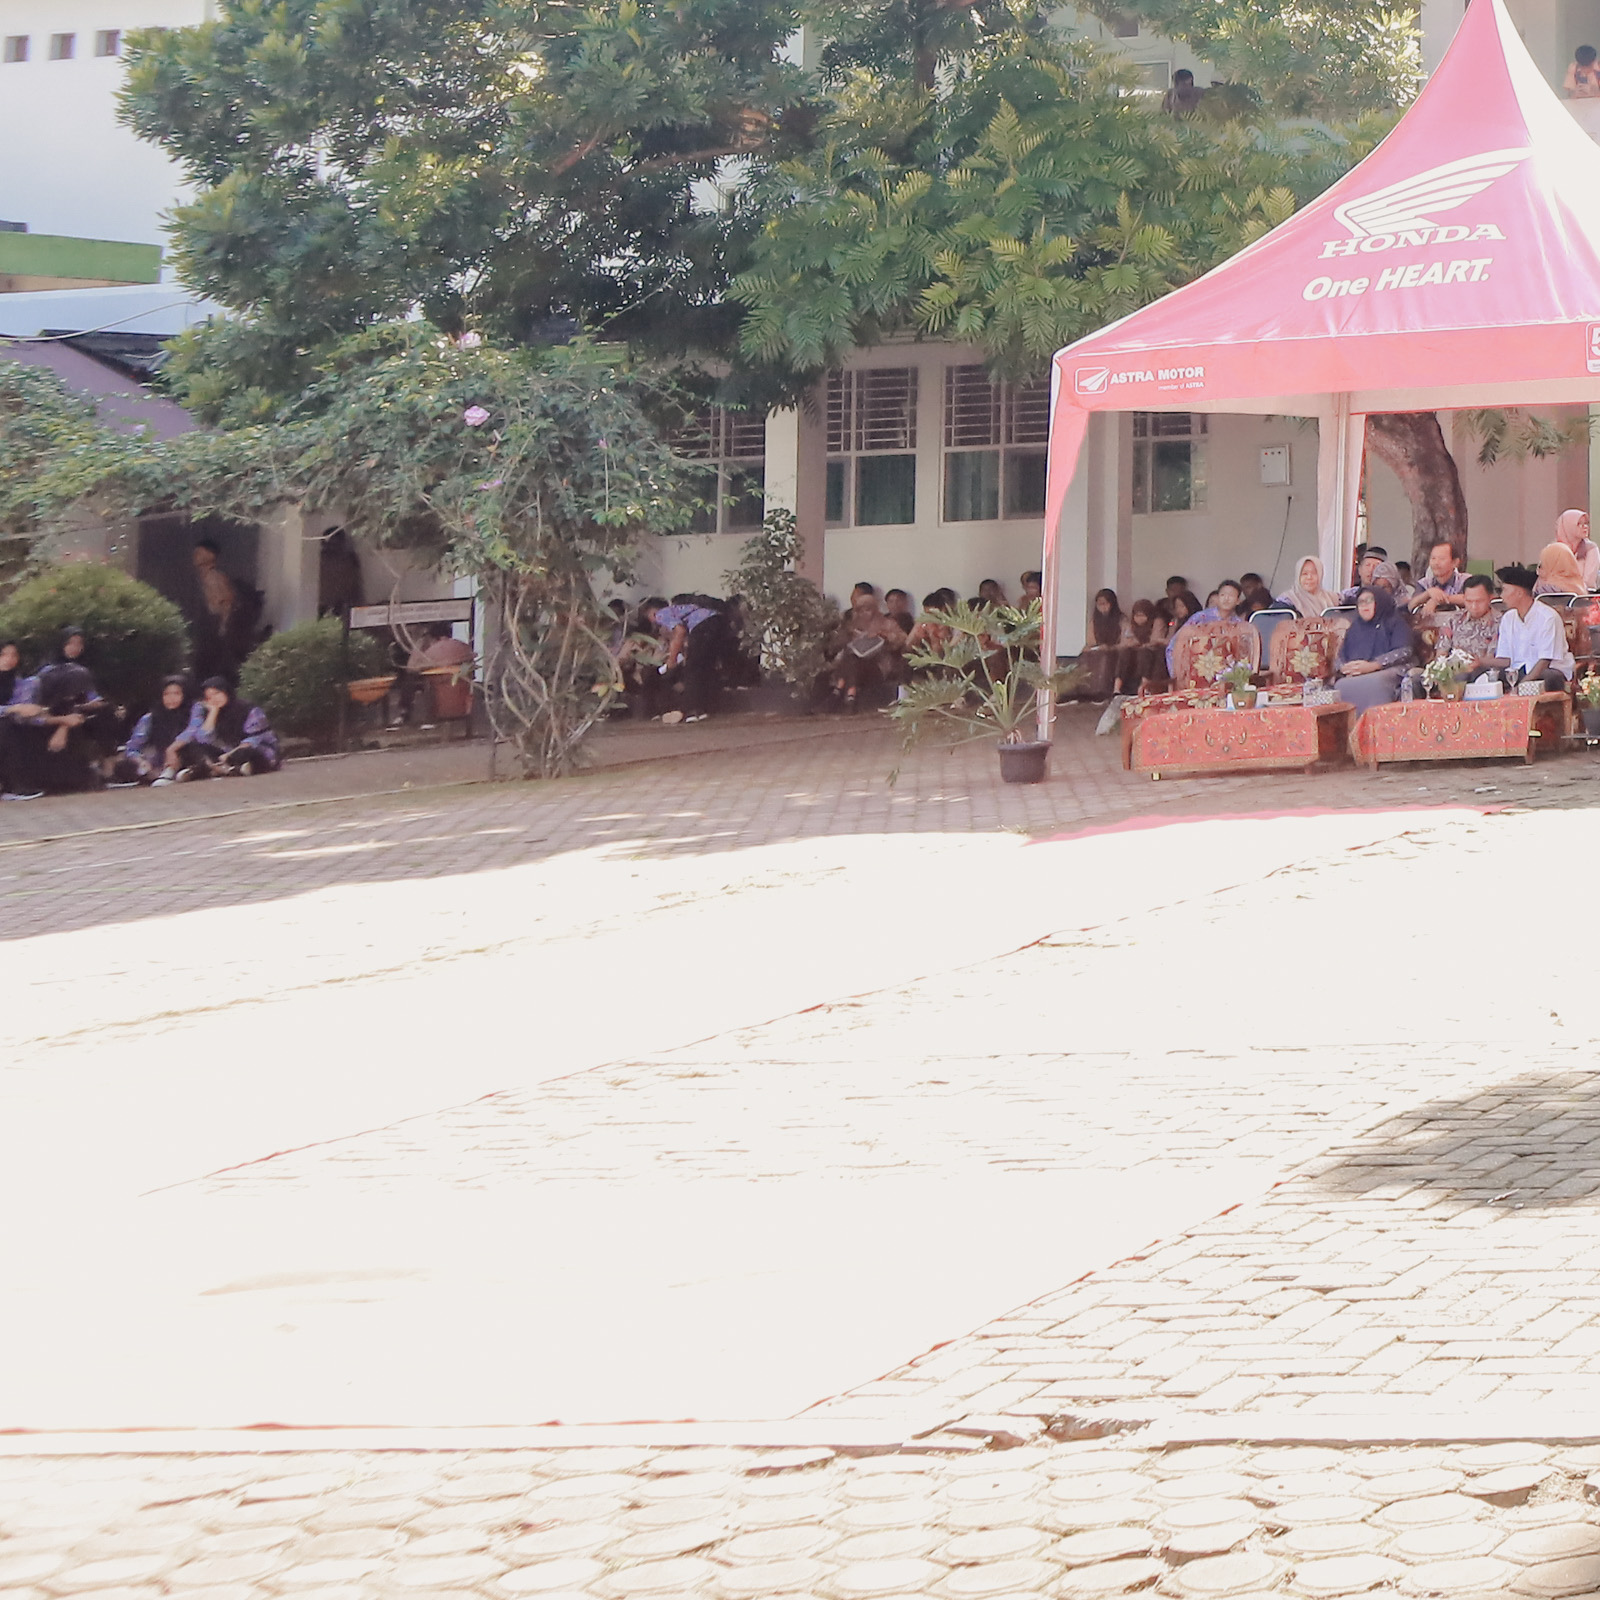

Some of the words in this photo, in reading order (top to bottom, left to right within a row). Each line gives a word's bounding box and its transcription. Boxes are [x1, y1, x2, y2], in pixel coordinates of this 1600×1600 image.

[1317, 223, 1507, 259] HONDA
[1302, 276, 1370, 301] One
[1374, 258, 1494, 292] HEART.
[1110, 370, 1154, 385] ASTRA
[1158, 366, 1204, 381] MOTOR
[1185, 381, 1205, 389] ASTRA
